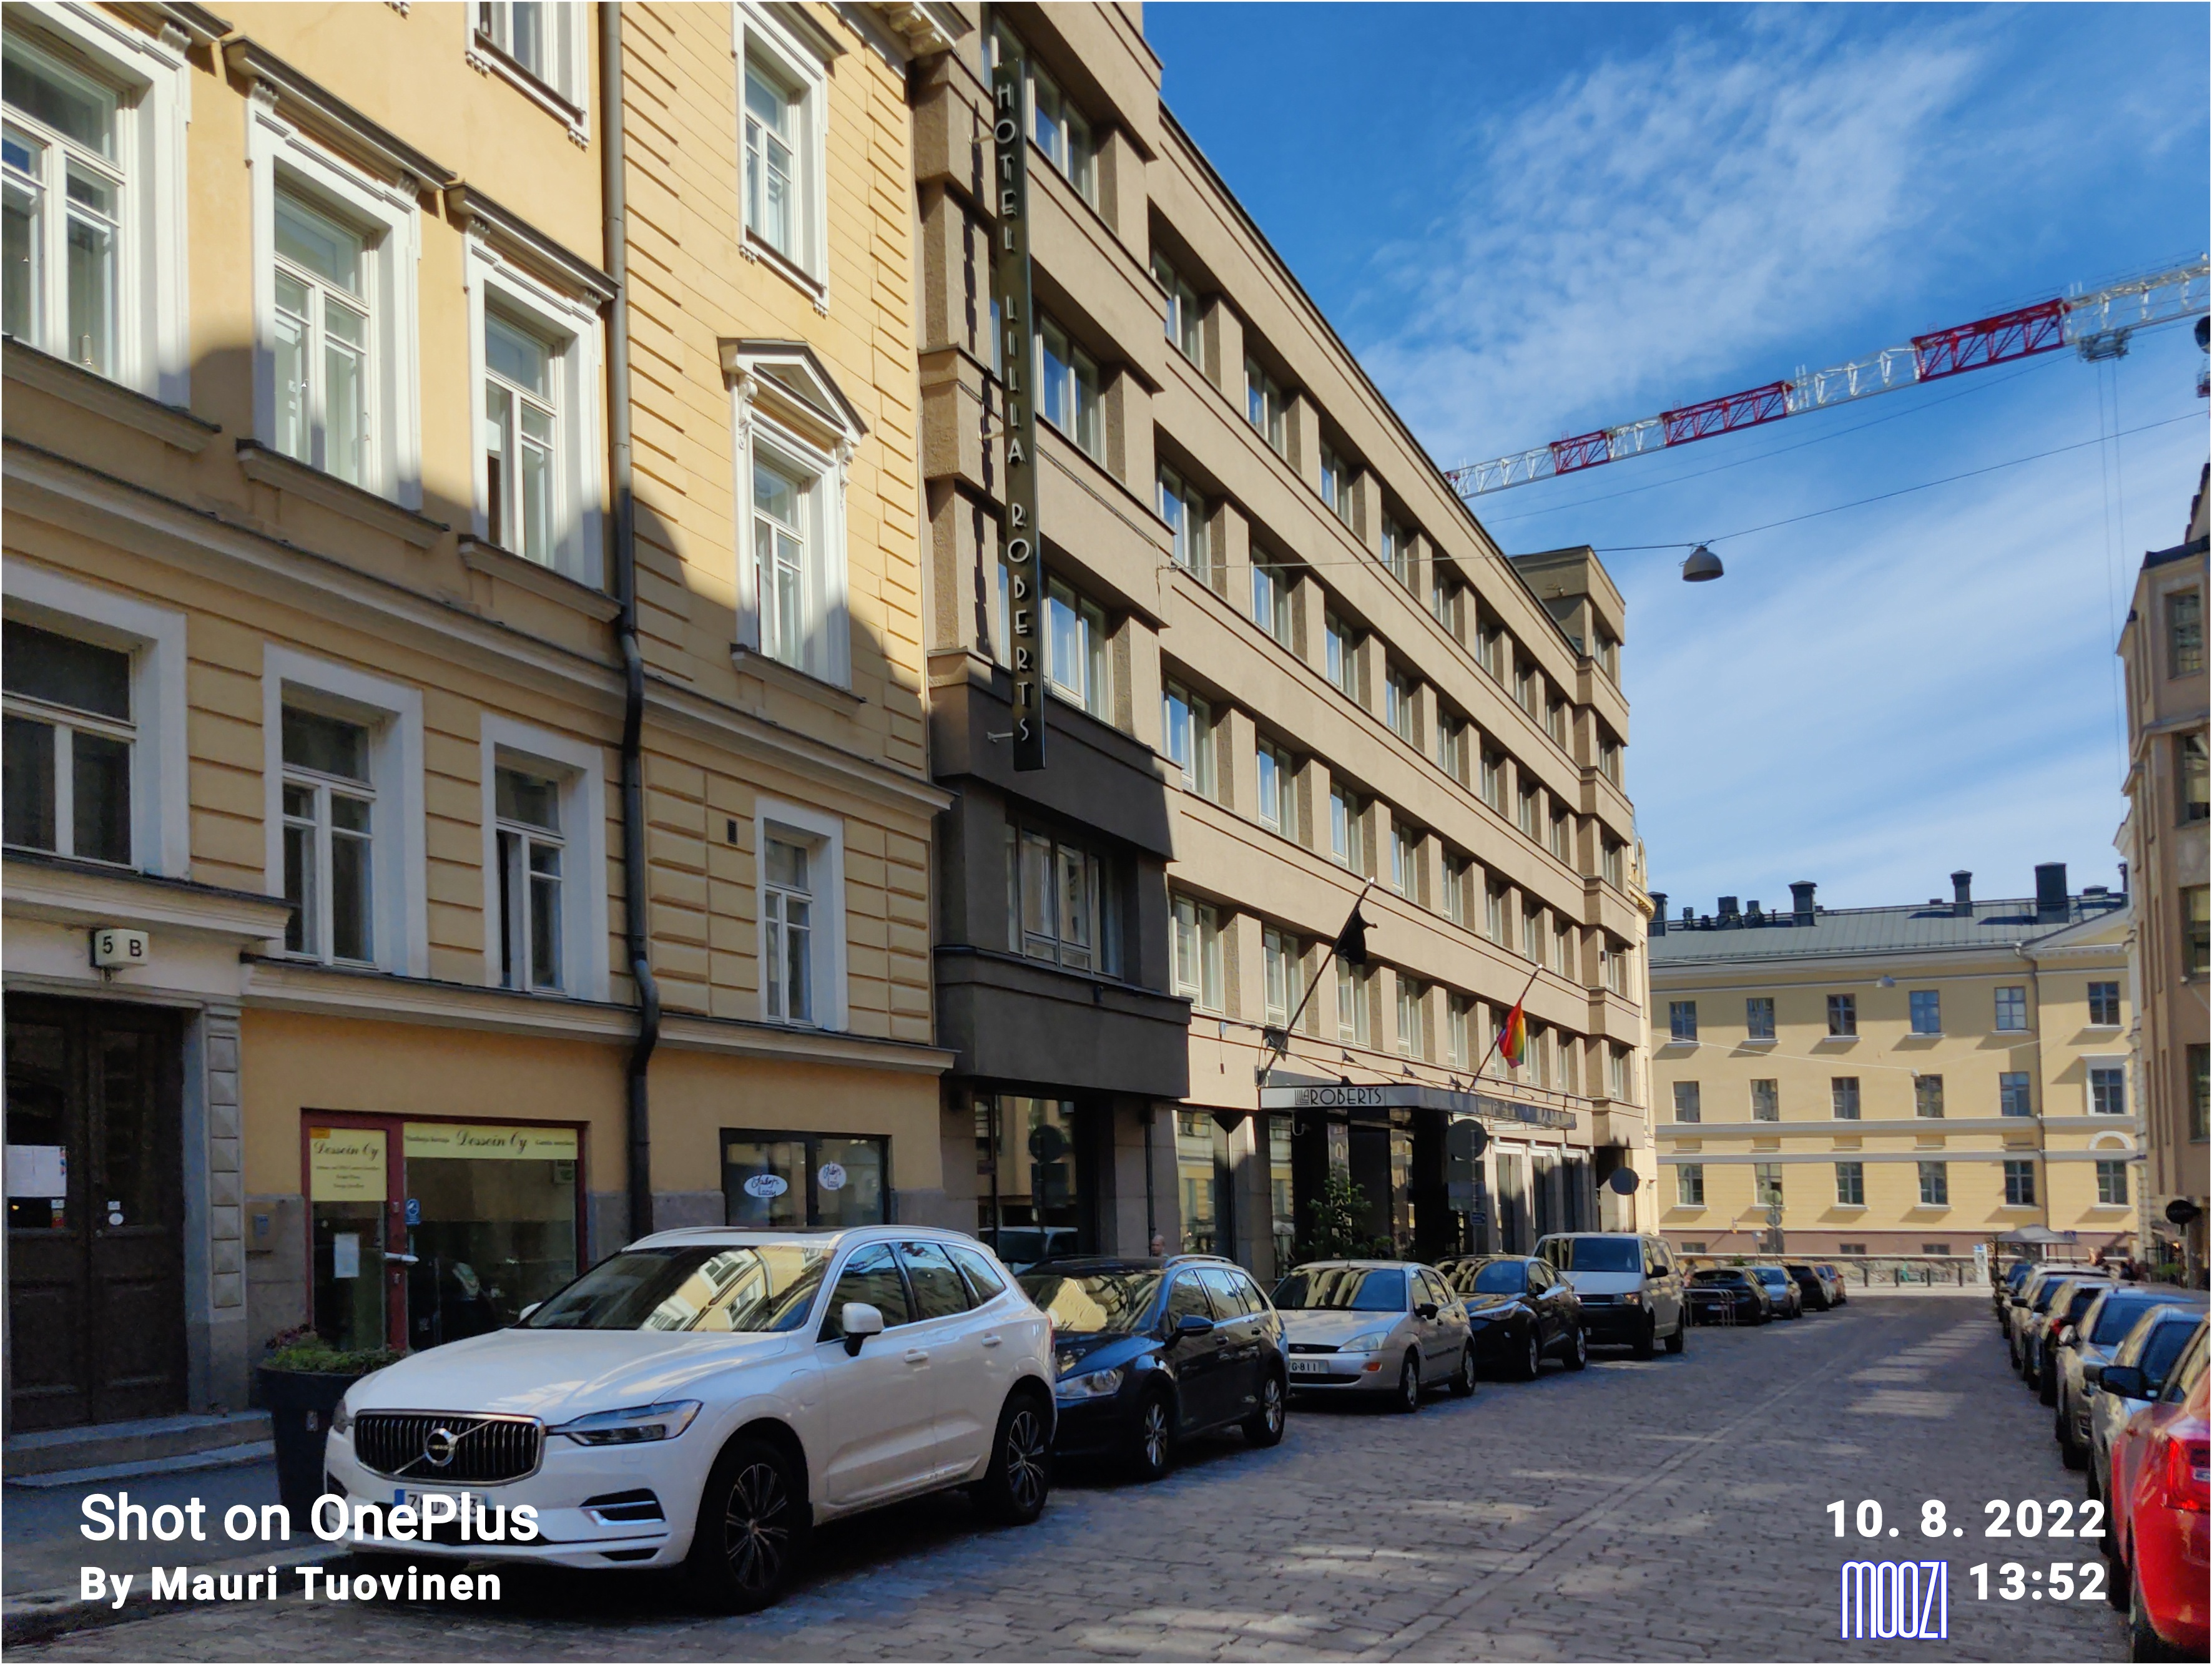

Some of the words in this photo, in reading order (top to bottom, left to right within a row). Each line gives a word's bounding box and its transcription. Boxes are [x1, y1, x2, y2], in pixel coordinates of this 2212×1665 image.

[994, 82, 1017, 252] HOTEL
[1006, 295, 1026, 463] LILLA
[1008, 502, 1033, 742] ROBERTS
[103, 935, 114, 954] 5
[129, 939, 142, 957] B
[1310, 1088, 1382, 1106] ROBERTS
[362, 1142, 379, 1161] Oy
[509, 1131, 528, 1154] Oy
[1289, 1362, 1316, 1372] G-811
